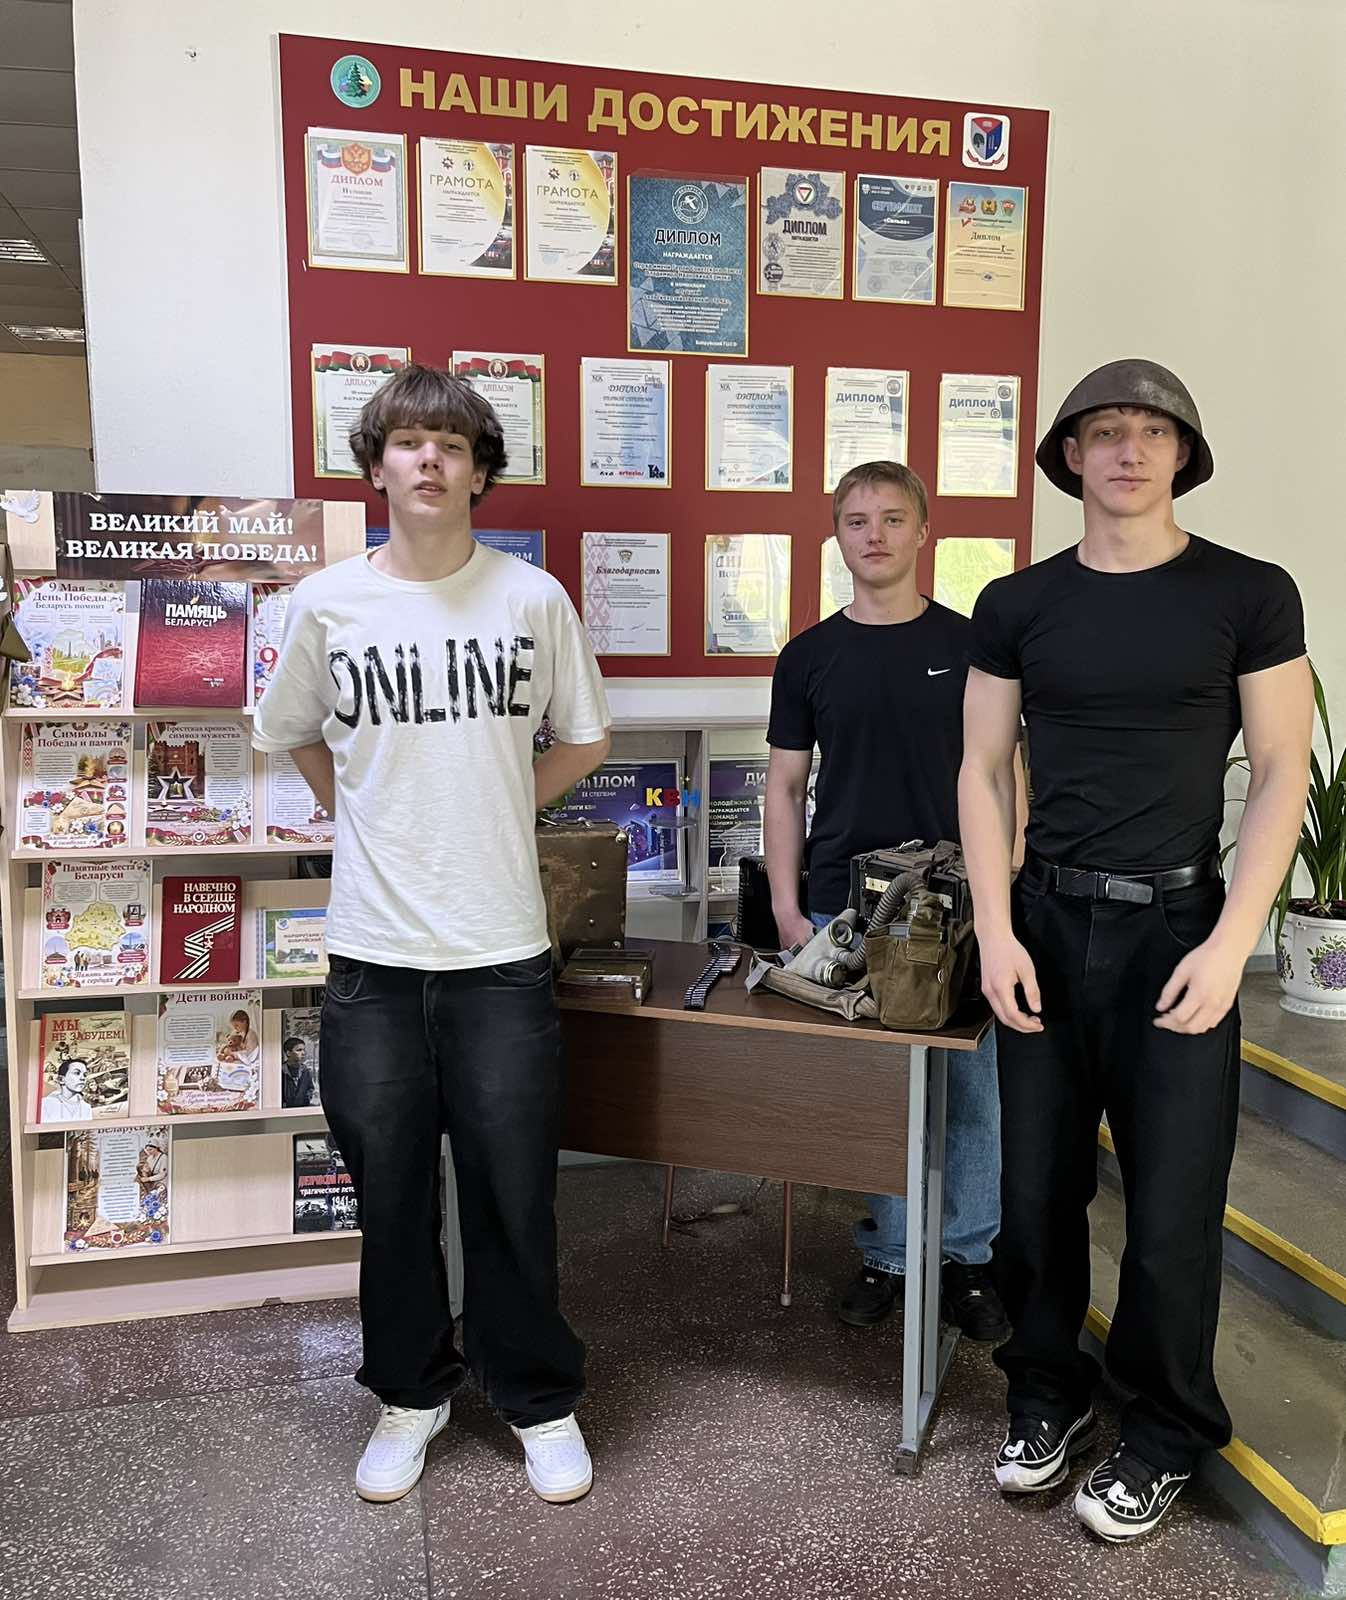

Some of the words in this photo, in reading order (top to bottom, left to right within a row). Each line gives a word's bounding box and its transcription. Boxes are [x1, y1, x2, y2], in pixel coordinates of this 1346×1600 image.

[399, 68, 568, 122] НАШИ
[588, 87, 951, 156] ДОСТИЖЕНИЯ
[330, 174, 384, 187] ДИПЛОМ
[429, 174, 494, 190] ГРАМОТА
[537, 185, 600, 200] ГРАМОТА
[782, 220, 827, 236] ДИПЛОМ
[655, 229, 721, 245] ДИПЛОМ
[970, 231, 1001, 241] Диплом
[663, 251, 712, 260] НАГРАЖДАЕТСЯ
[835, 392, 885, 403] ДИПЛОМ
[948, 398, 996, 408] ДИПЛОМ
[89, 510, 219, 534] ВЕЛИКИЙ
[228, 512, 294, 535] МАЙ!
[66, 540, 194, 560] ВЕЛИКАЯ
[201, 542, 318, 564] ПОБЕДА!
[596, 566, 660, 576] Благодарность
[49, 582, 57, 592] 9
[60, 583, 85, 592] Мая
[33, 592, 61, 602] День
[64, 593, 107, 602] Победы
[35, 602, 73, 610] Беларусь
[165, 603, 228, 623] ПАМЯЦЬ
[164, 617, 213, 627] БЕЛАРУСІ
[259, 646, 279, 672] 9
[328, 636, 535, 729] ONLINE
[52, 729, 107, 739] Символы
[38, 738, 78, 748] Победы
[89, 739, 124, 747] памяти
[575, 775, 636, 789] ИПЛОМ
[63, 863, 108, 873] Памятные
[110, 864, 135, 872] места
[75, 871, 124, 881] Беларуси
[184, 882, 237, 893] НАВЕЧНО
[183, 893, 192, 903] В
[192, 893, 236, 904] СЕРДЦЕ
[173, 903, 236, 914] НАРОДНОМ
[176, 992, 207, 1004] Дети
[210, 991, 248, 1001] войны
[52, 1019, 80, 1032] МЫ
[52, 1031, 67, 1041] НЕ
[70, 1029, 125, 1041] ЗАБУДЕМ!
